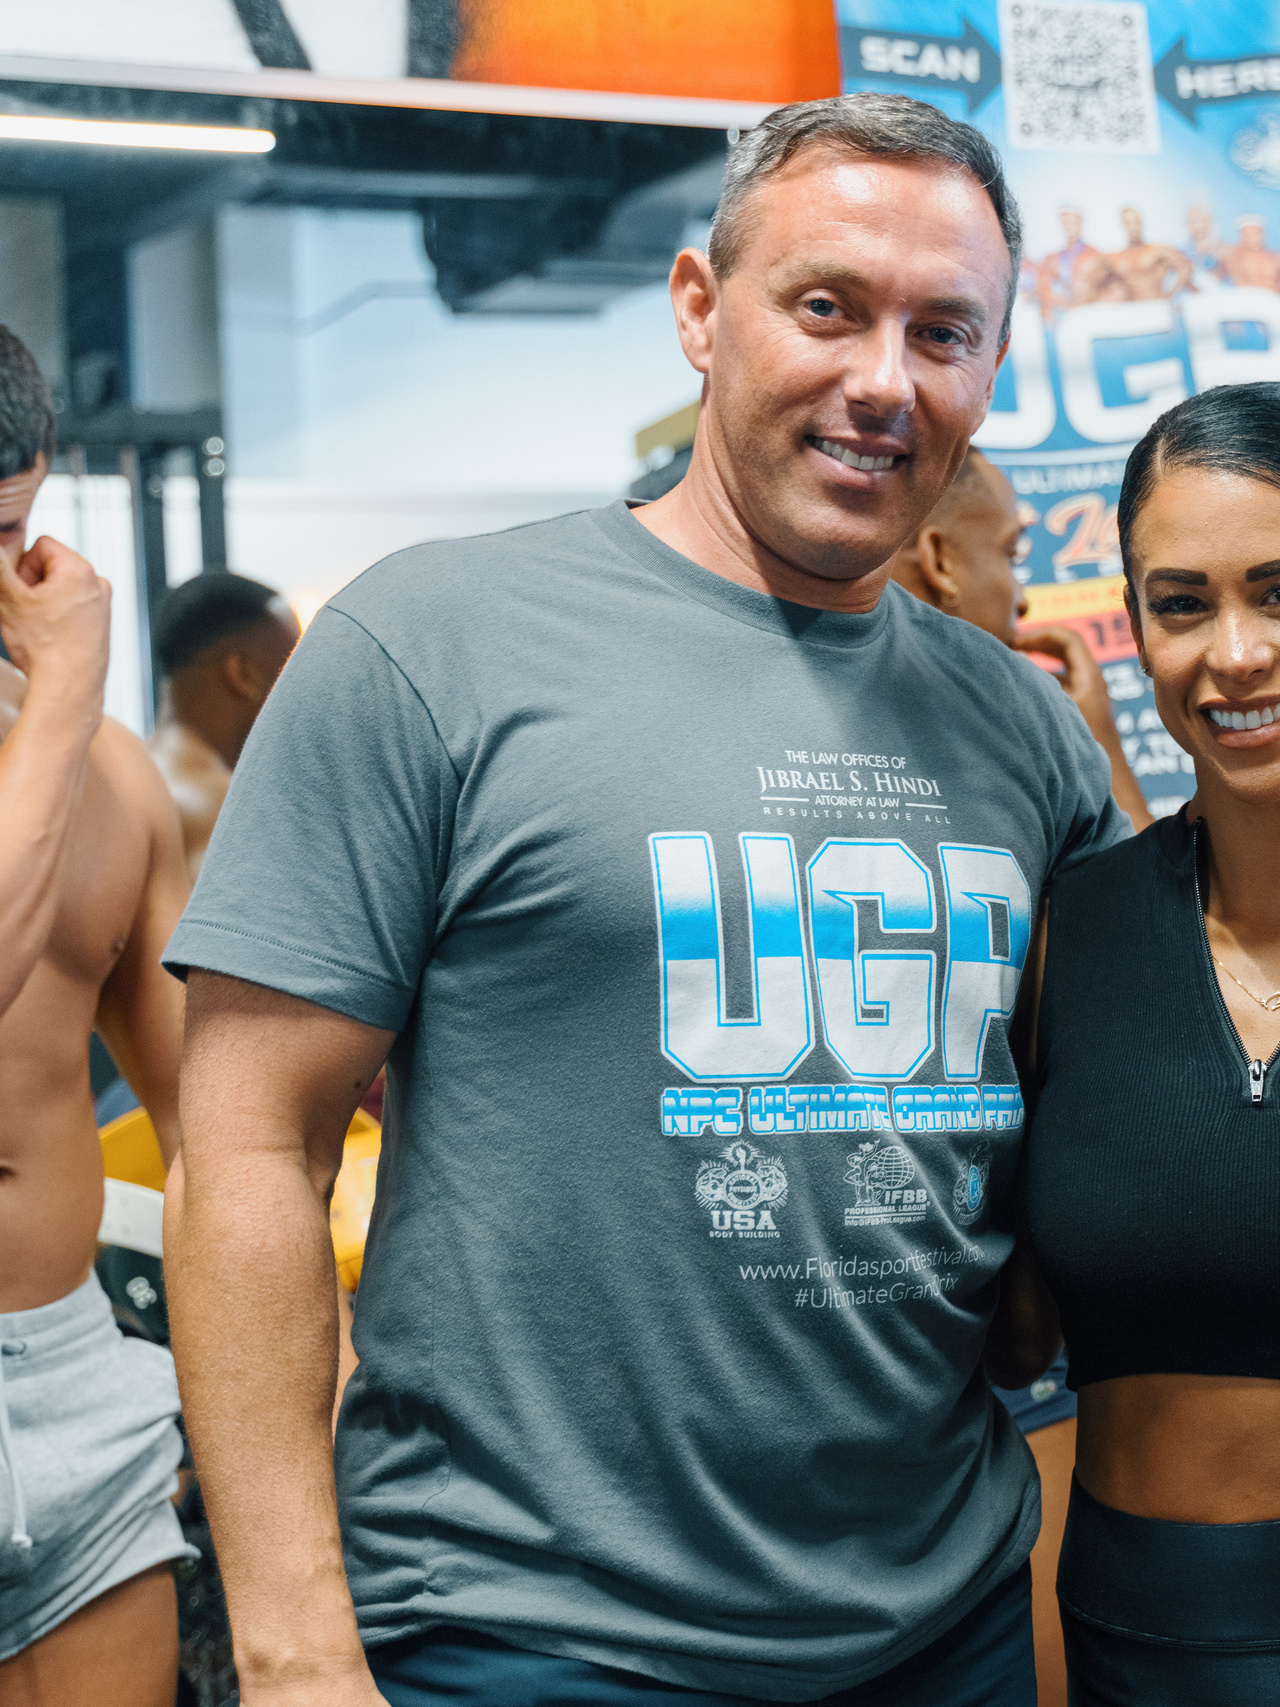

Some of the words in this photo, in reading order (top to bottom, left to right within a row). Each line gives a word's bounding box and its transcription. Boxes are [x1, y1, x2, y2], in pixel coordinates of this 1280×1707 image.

[860, 36, 981, 84] SCAN
[785, 750, 809, 764] THE
[812, 752, 838, 765] LAW
[841, 753, 890, 769] OFFICES
[891, 756, 907, 770] OF
[756, 766, 845, 793] JIBRAEL
[850, 770, 868, 792] S.
[872, 771, 942, 797] HINDI
[815, 795, 863, 808] ATTORNEY
[866, 796, 877, 808] AT
[879, 797, 900, 808] LAW
[764, 807, 843, 819] RESULTS
[857, 811, 912, 822] ABOVE
[925, 814, 951, 824] ALL
[647, 831, 1032, 1083] UGP
[660, 1086, 743, 1136] NPC
[747, 1083, 894, 1133] ULTIMATE
[892, 1084, 982, 1132] GRAND
[884, 1189, 927, 1204] IFBB
[710, 1210, 777, 1230] USA
[844, 1206, 897, 1215] PROFESSIONAL
[709, 1230, 733, 1238] BODY
[738, 1230, 781, 1239] BUILDING
